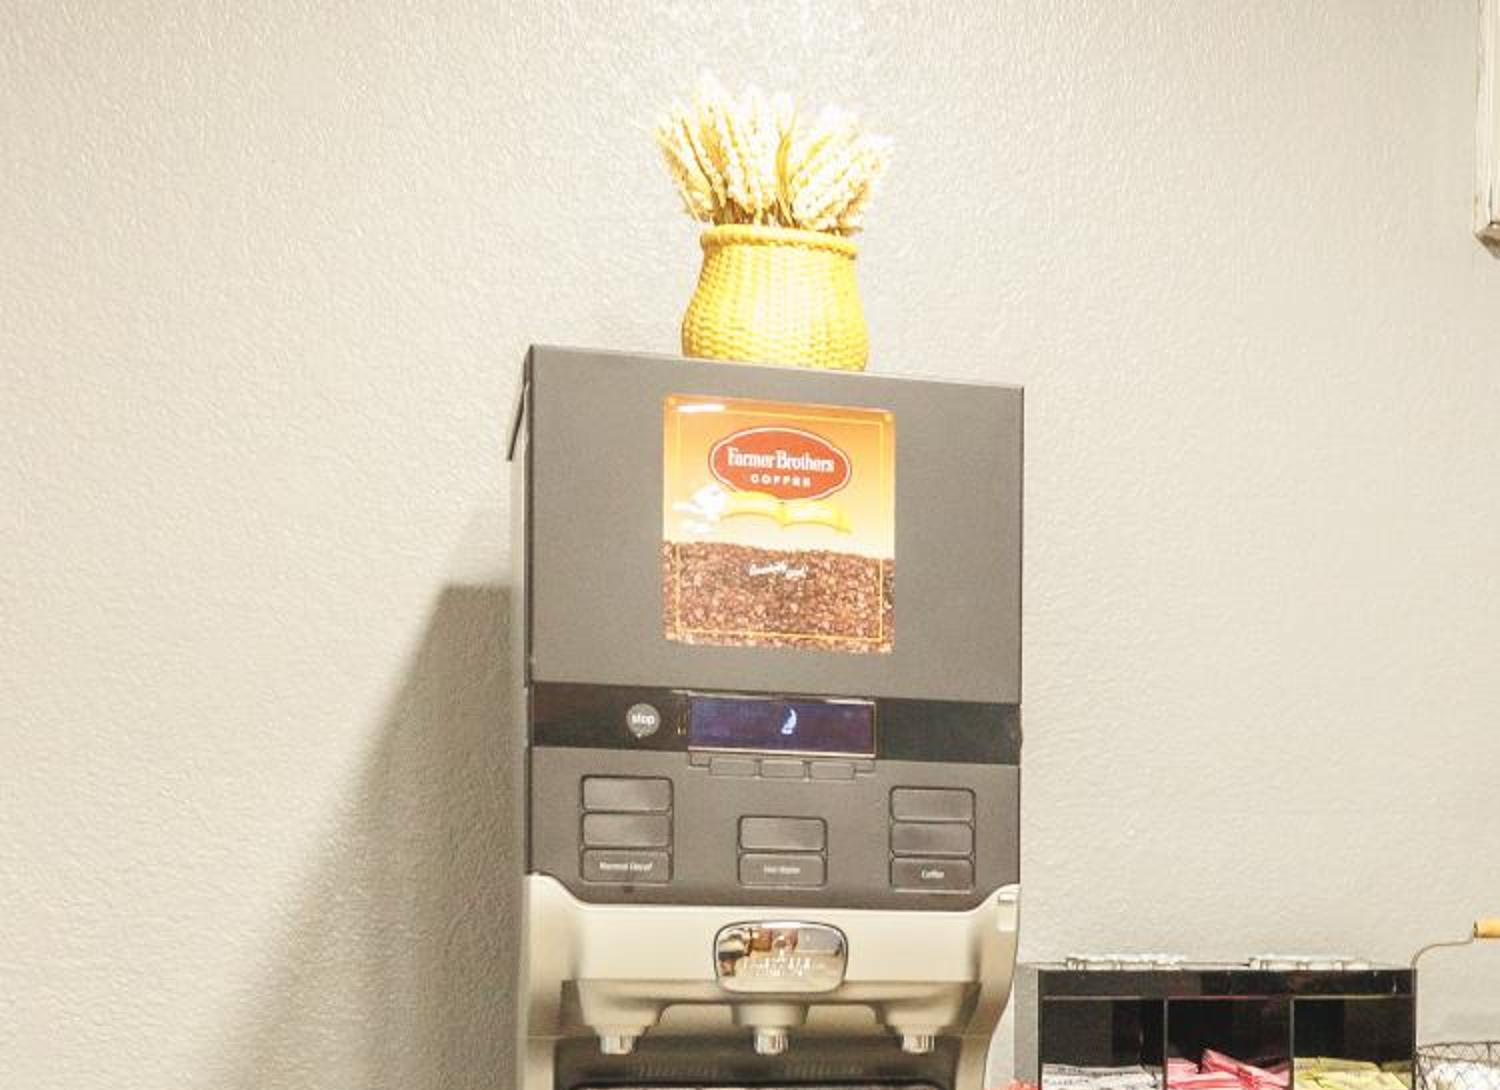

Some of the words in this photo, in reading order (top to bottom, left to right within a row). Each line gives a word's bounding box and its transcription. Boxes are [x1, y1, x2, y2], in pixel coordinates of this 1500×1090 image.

[727, 445, 775, 468] Farmer
[775, 448, 835, 473] Brothers
[750, 472, 812, 488] COFFEE
